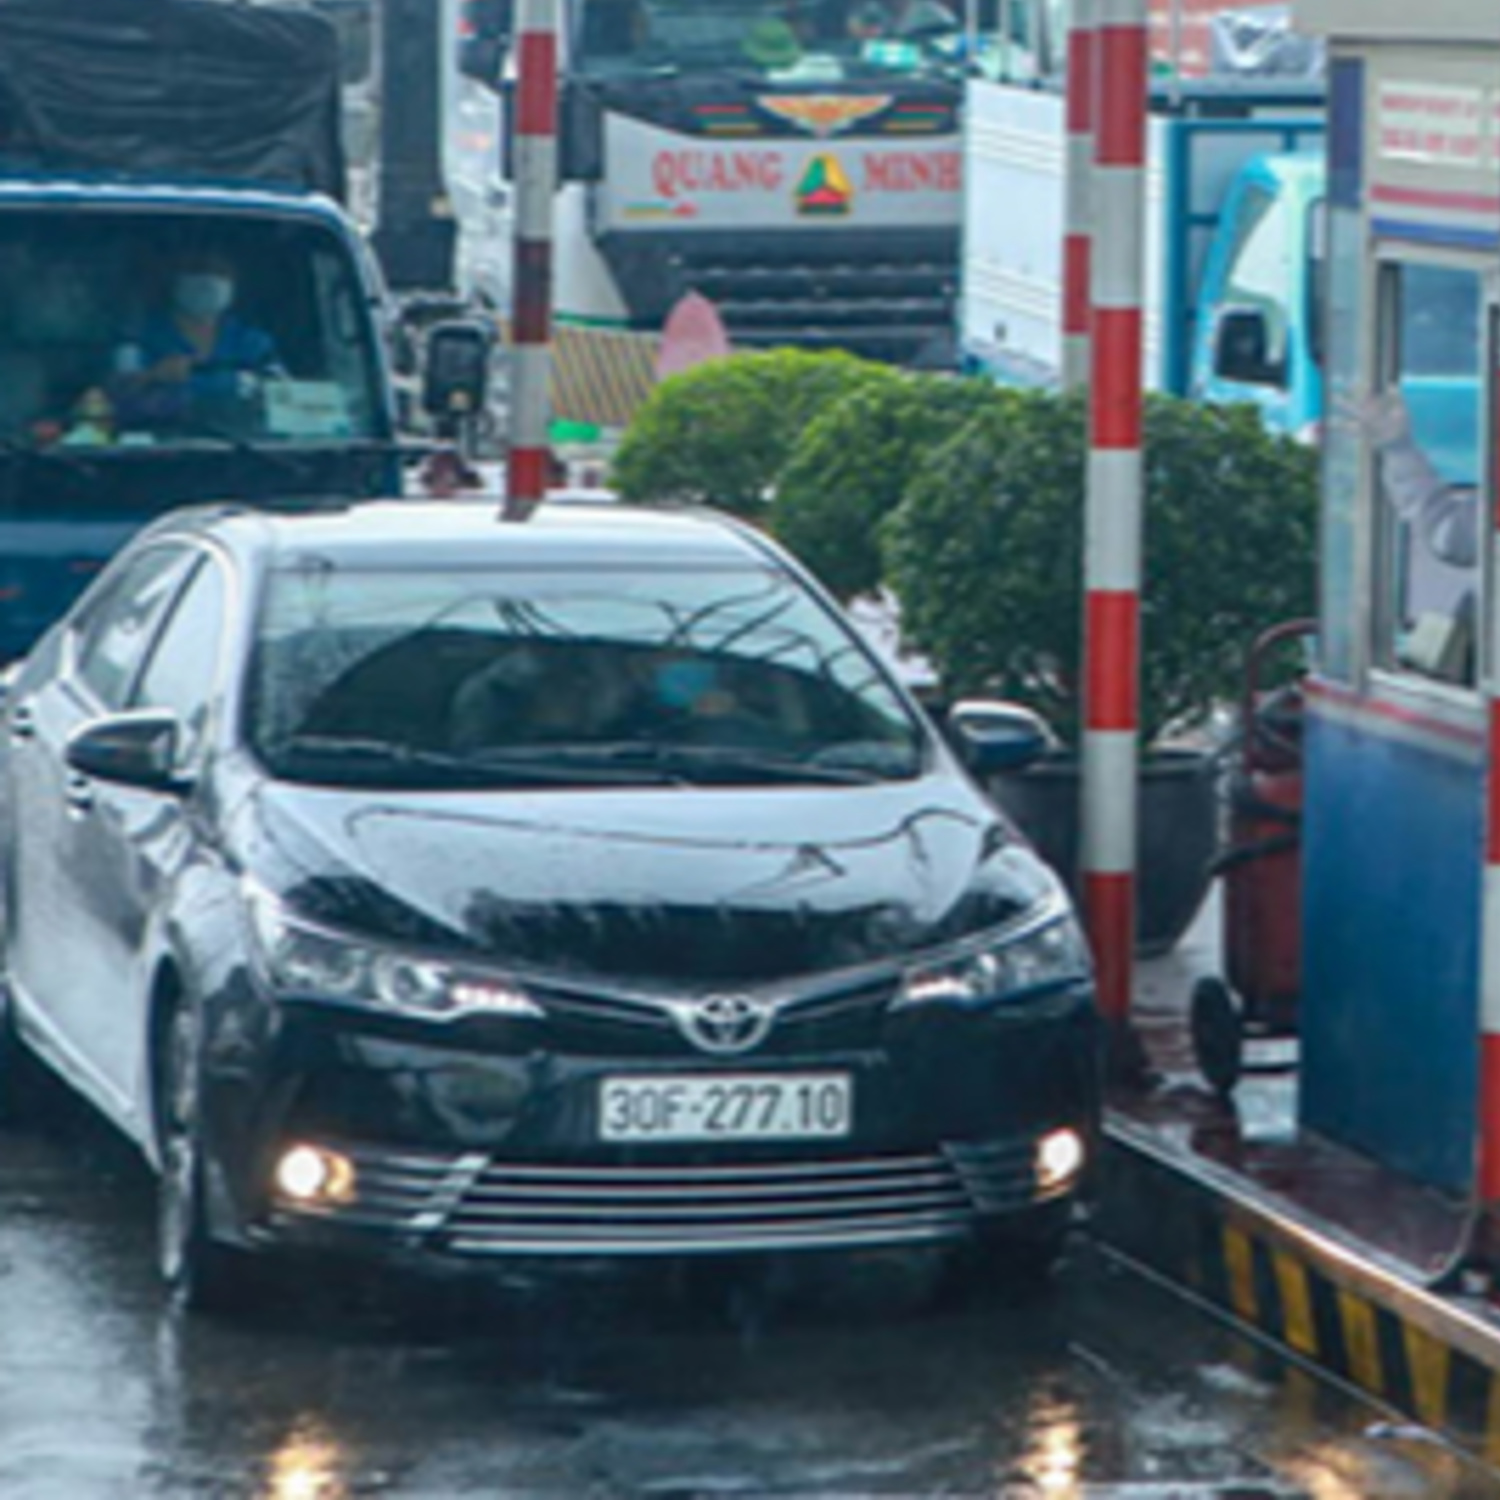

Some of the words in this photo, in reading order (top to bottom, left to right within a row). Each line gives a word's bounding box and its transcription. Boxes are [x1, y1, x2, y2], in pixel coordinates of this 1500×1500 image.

[652, 150, 783, 198] QUANG
[861, 151, 963, 192] MINH
[607, 1080, 846, 1134] 30F-277.10
